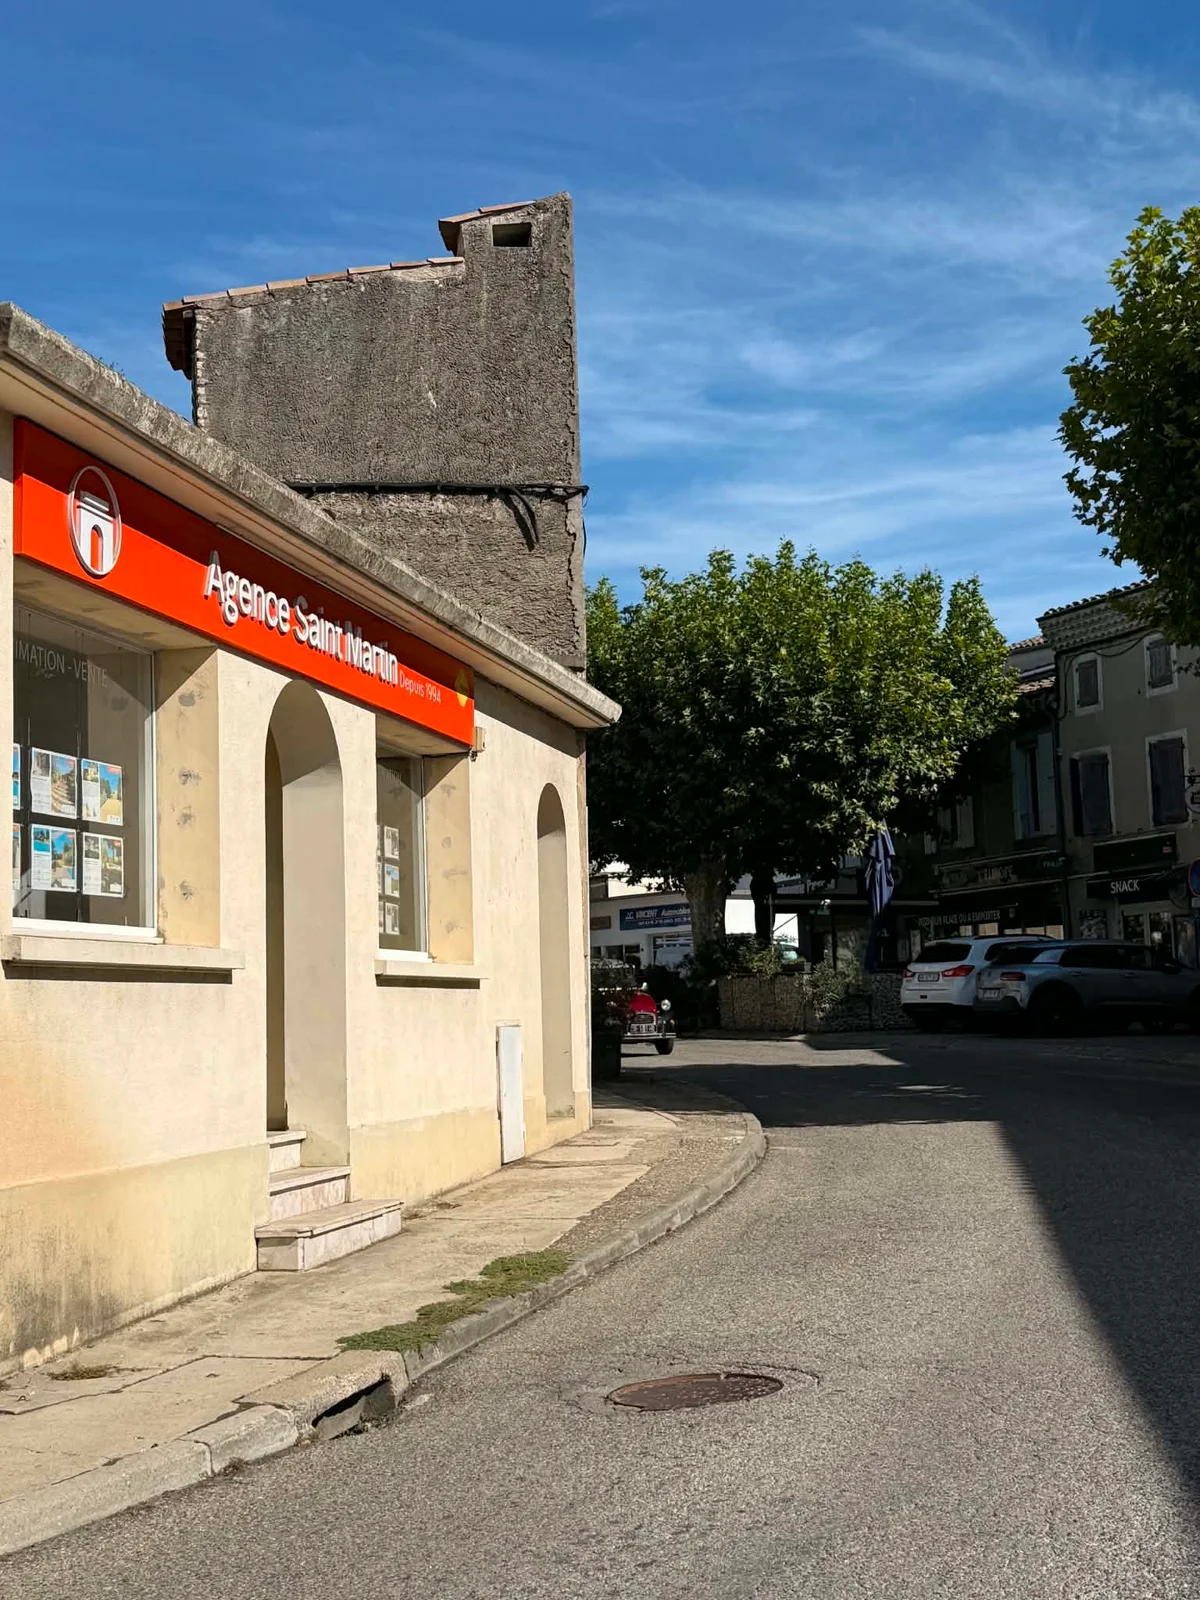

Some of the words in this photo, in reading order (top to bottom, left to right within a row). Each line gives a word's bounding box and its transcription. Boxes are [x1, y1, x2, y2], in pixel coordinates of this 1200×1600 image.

[203, 550, 290, 633] Agence
[293, 595, 344, 661] Saint
[345, 620, 398, 688] Martin
[73, 658, 108, 688] VENTE
[399, 669, 425, 698] Depuis
[425, 682, 442, 705] 1994
[1110, 879, 1140, 894] SNACK
[636, 909, 658, 918] VINCENT
[958, 912, 967, 923] OU
[972, 910, 1000, 922] EMPORTER
